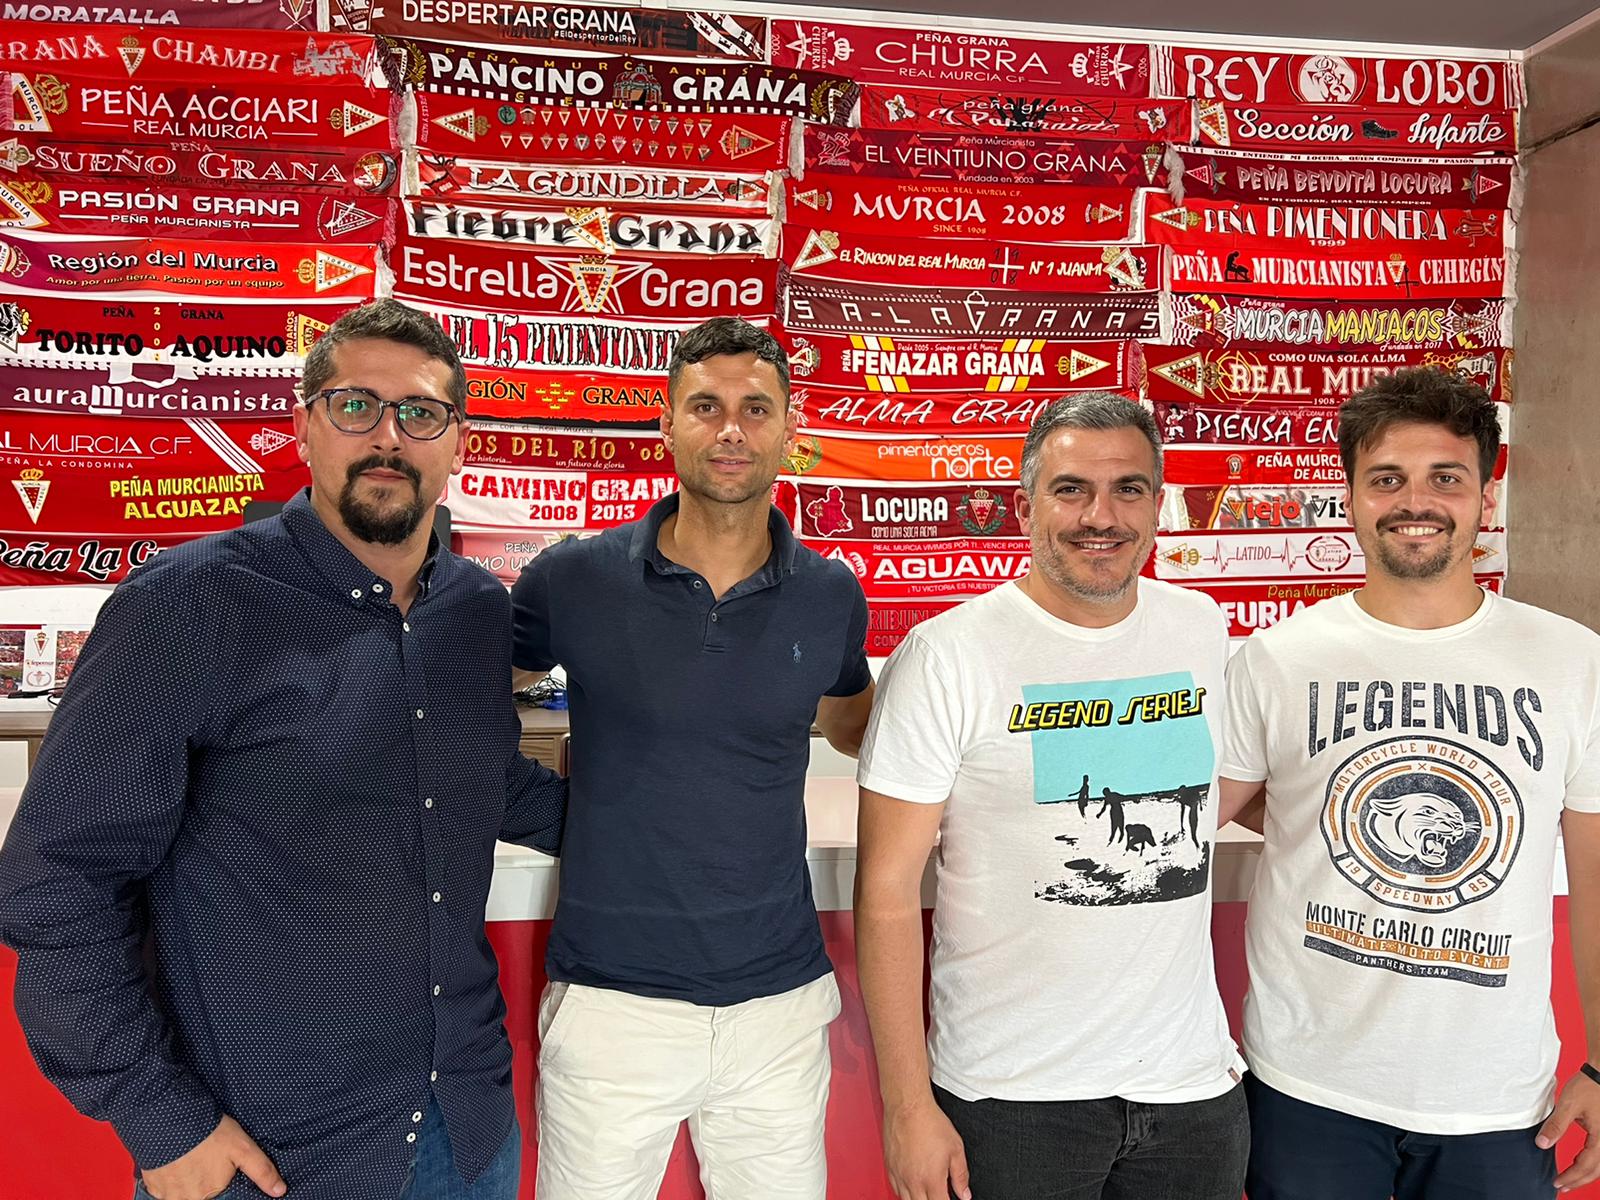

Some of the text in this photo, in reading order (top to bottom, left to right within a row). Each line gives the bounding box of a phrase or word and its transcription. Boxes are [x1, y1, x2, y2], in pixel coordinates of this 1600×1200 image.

[3, 3, 180, 25] MORATALLA
[403, 0, 547, 29] DESPERTAR
[553, 6, 636, 35] GRANA
[811, 26, 821, 70] CHURRA
[915, 31, 1009, 46] PEÑA GRANA
[152, 37, 280, 73] CHAMBI
[875, 41, 1049, 75] CHURRA
[1101, 45, 1110, 87] CHURRA
[428, 52, 806, 107] PANCINO GRANA
[899, 67, 1001, 82] REAL MURCIA
[1184, 54, 1496, 106] REY LOBO
[18, 80, 43, 122] MURCIA
[81, 85, 175, 116] PEÑA
[183, 95, 318, 124] ACCIARI
[963, 98, 1084, 115] peña grana
[133, 120, 268, 140] REAL MURCIA
[959, 135, 1036, 147] Peña Murcianista
[1234, 109, 1506, 150] Sección Infante
[170, 141, 213, 152] PEÑA
[865, 145, 1127, 172] EL VEINTIUNO GRANA
[35, 145, 176, 176] SUEÑO
[198, 152, 347, 183] GRANA
[468, 166, 725, 202] LA GUINDILLA
[898, 185, 1007, 196] PEÑA REAL MURCIA
[958, 174, 999, 184] Fundada
[1014, 176, 1035, 184] 2003
[1236, 164, 1453, 195] PEÑA BENDITA LOCURA
[59, 188, 299, 216] PASIÓN GRANA
[853, 192, 1066, 226] MURCIA 2008
[111, 212, 250, 229] PEÑA MURCIANISTA
[409, 201, 764, 251] Fiebre Grana
[932, 224, 963, 233] SINCE
[1204, 203, 1447, 240] PEÑA PIMENTONERA
[48, 249, 278, 273] Región del Murcia
[839, 247, 986, 270] EL RINCON DEL REAL MURCIA
[1056, 262, 1103, 277] JUANMI
[1172, 250, 1503, 286] PEÑA MURCIANISTA CEHEGÍN
[46, 275, 284, 288] Amor Pasión por equipo
[403, 247, 763, 307] Estrella Grana
[103, 306, 135, 318] PEÑA
[181, 309, 224, 320] GRANA
[36, 328, 144, 356] TORITO
[170, 334, 287, 363] AQUINO
[449, 313, 520, 368] EL 15
[914, 343, 930, 351] 2005
[1379, 342, 1414, 351] Fundada
[840, 350, 851, 371] PEÑA
[852, 350, 1045, 376] FENAZAR GRANA
[1269, 353, 1305, 363] COMO
[1308, 355, 1334, 363] UNA
[1371, 354, 1406, 363] ALMA
[1230, 362, 1312, 395] REAL
[582, 386, 666, 407] GRANA
[1314, 397, 1335, 405] 1908
[818, 396, 934, 427] ALMA
[1195, 411, 1291, 443] PIENSA
[30, 432, 142, 454] MURCIA
[150, 436, 192, 455] C.F.
[511, 436, 616, 459] DEL RÍO
[878, 441, 985, 459] pimentoneros
[0, 457, 30, 466] PEÑA
[61, 461, 134, 469] CONDOMINA
[466, 454, 477, 462] de
[567, 459, 592, 468] futuro
[604, 461, 626, 470] gloria
[931, 448, 1014, 479] norte
[1256, 452, 1293, 468] PEÑA
[110, 474, 265, 498] PEÑA MURCIANISTA
[1294, 469, 1309, 480] DE
[461, 473, 587, 502] CAMINO
[529, 503, 636, 521] 2008 2013
[861, 493, 948, 523] LOCURA
[871, 527, 890, 538] COMO
[504, 542, 538, 552] PEÑA
[873, 543, 892, 551] REAL
[893, 543, 922, 551] MURCIA
[922, 542, 953, 551] VIVIMOS
[953, 541, 969, 549] POR
[1236, 546, 1272, 561] LATIDO
[78, 540, 123, 581] La
[922, 584, 956, 592] VICTORIA
[1008, 687, 1207, 733] LEGEND SERIES
[1307, 680, 1544, 772] LEGENDS
[1333, 742, 1512, 806] MOTORCYCLE WORLD TOUR
[1344, 861, 1489, 906] 19 SPEEDWAY 85
[1305, 900, 1513, 956] MONTE CARLO CIRCUIT
[1312, 923, 1503, 969] ULTIMATE MOTO EVENT
[1420, 966, 1449, 977] TEAM
